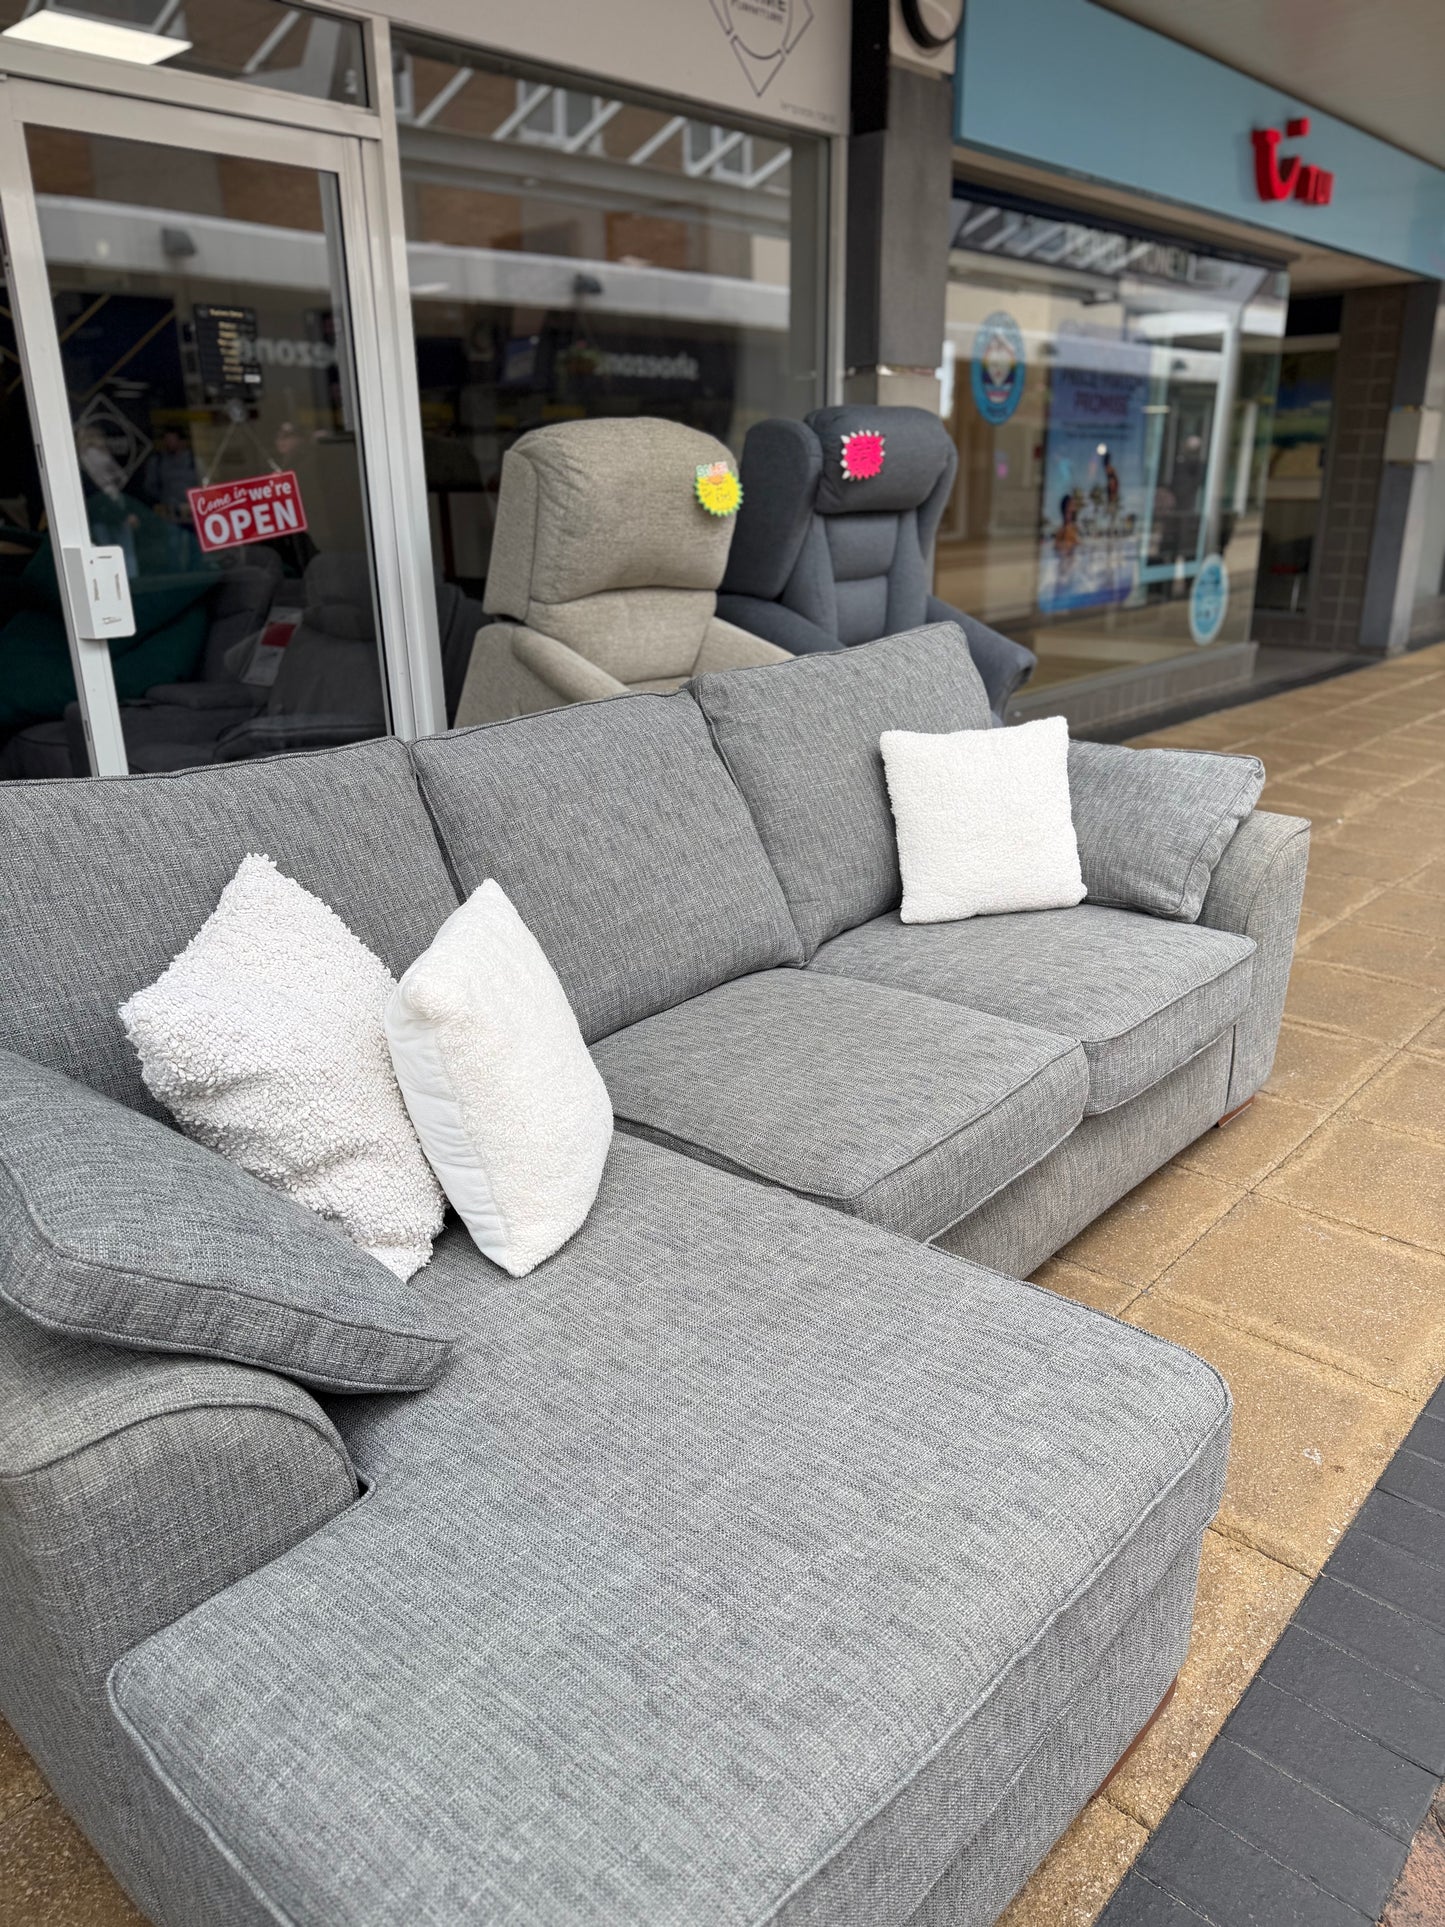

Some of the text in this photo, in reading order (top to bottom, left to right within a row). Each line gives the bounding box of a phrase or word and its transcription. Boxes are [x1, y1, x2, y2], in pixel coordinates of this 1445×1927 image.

[197, 480, 292, 515] Come in we're
[204, 498, 299, 545] OPEN
